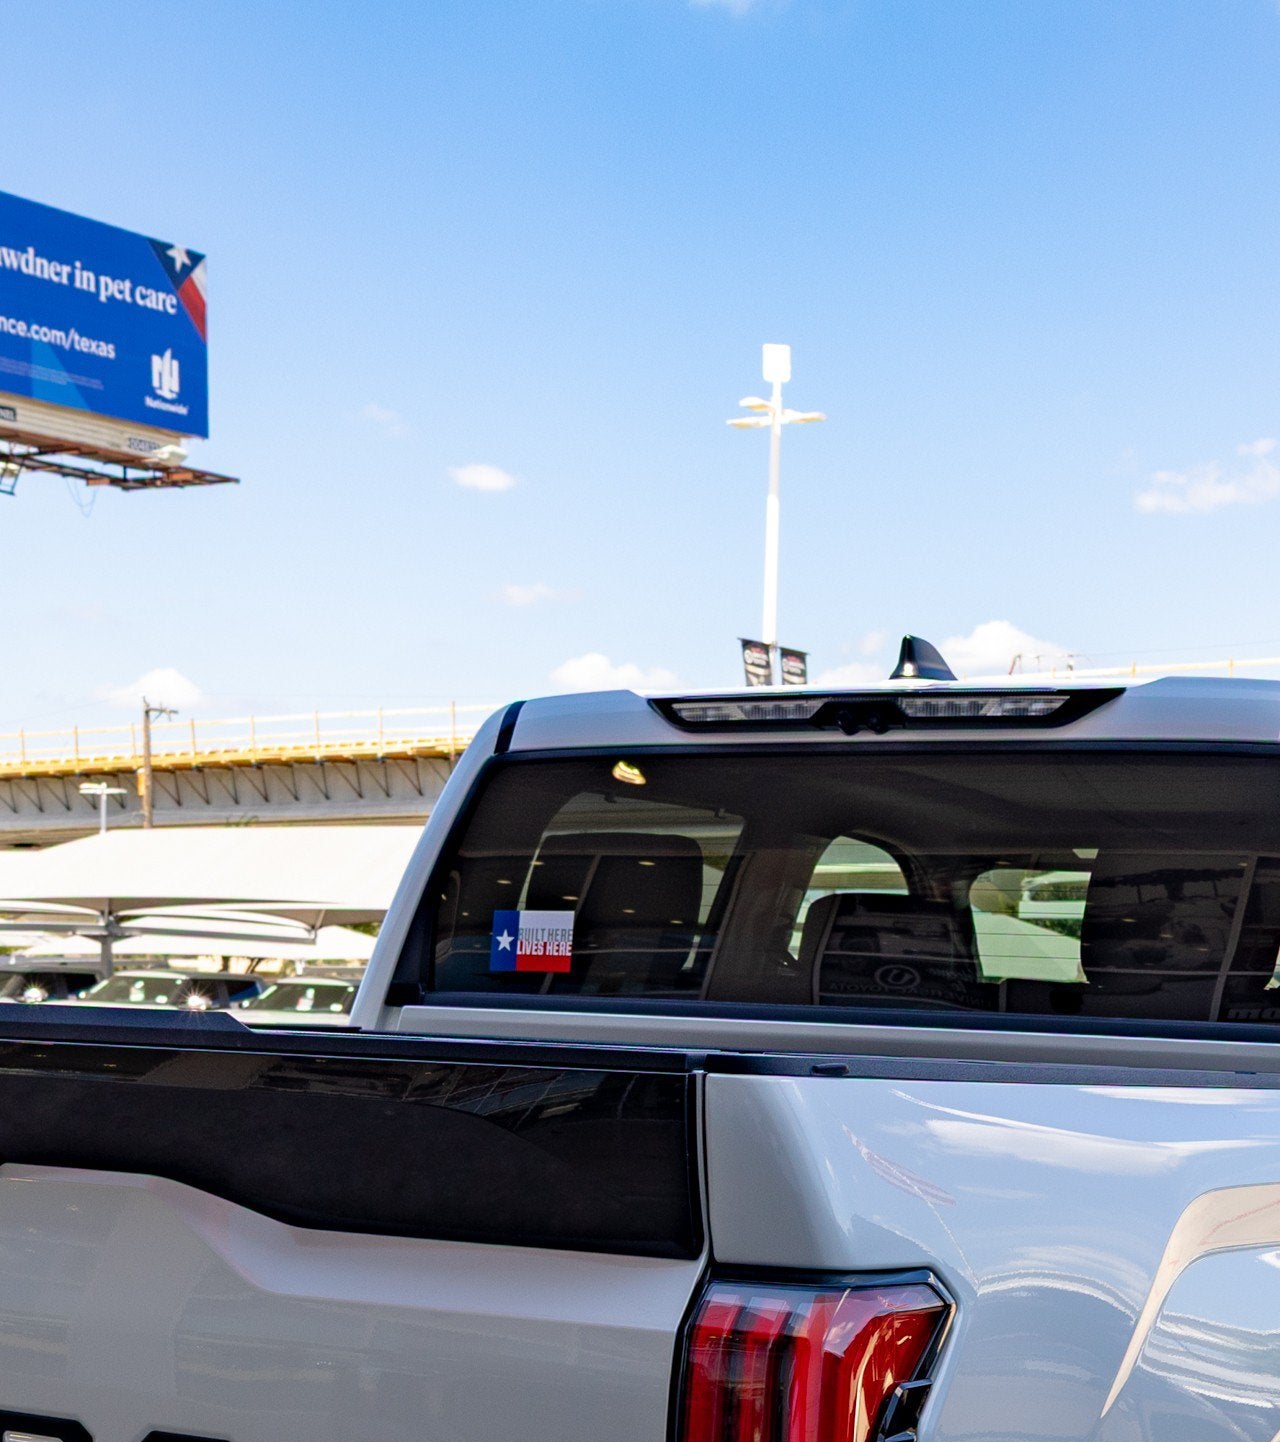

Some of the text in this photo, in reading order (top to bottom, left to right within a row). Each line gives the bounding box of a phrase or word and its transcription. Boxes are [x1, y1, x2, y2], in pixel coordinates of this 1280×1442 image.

[74, 261, 96, 293] in
[99, 274, 132, 304] pet
[135, 286, 178, 315] care
[518, 928, 574, 942] BUILT HERE
[516, 941, 572, 957] LIVES HERE
